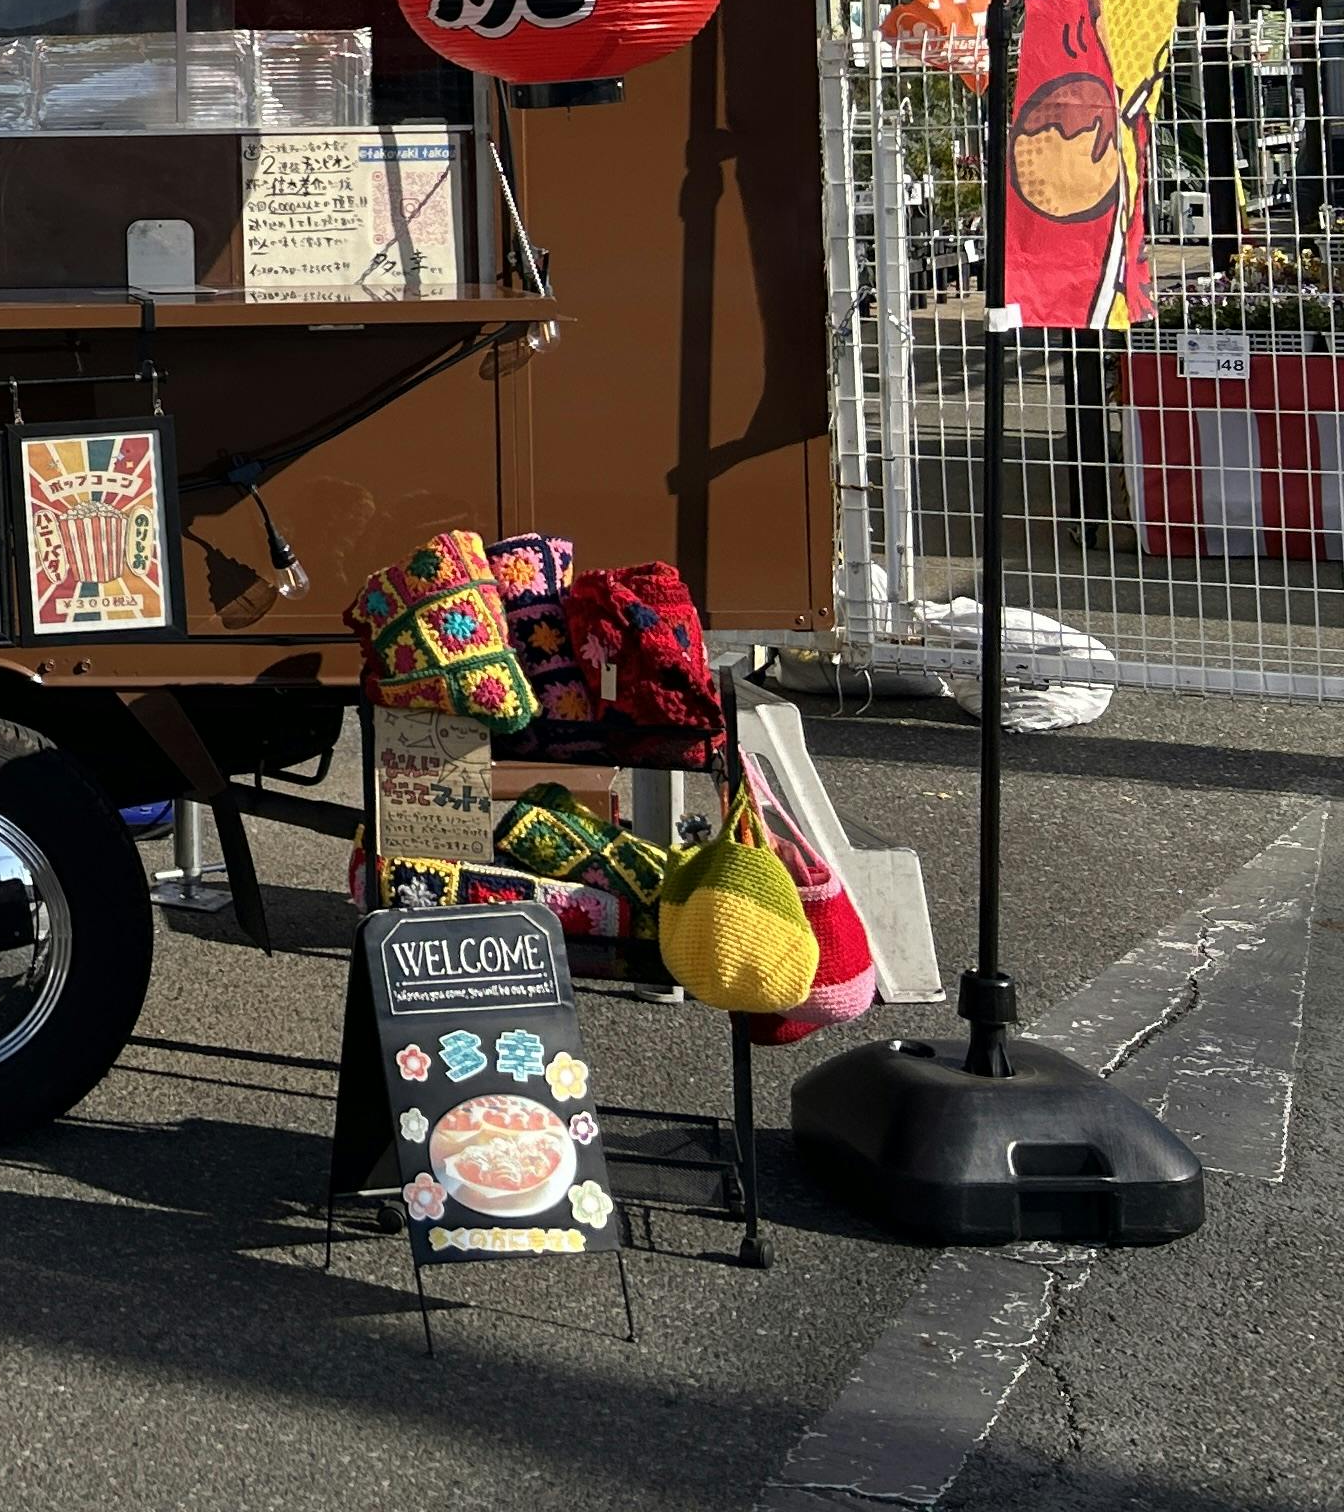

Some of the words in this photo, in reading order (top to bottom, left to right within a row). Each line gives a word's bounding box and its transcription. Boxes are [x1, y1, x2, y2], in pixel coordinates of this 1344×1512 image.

[48, 474, 134, 496] ポップコーン
[35, 513, 62, 583] ハニーバター
[392, 934, 544, 978] WELCOME
[438, 1028, 545, 1083] 多幸
